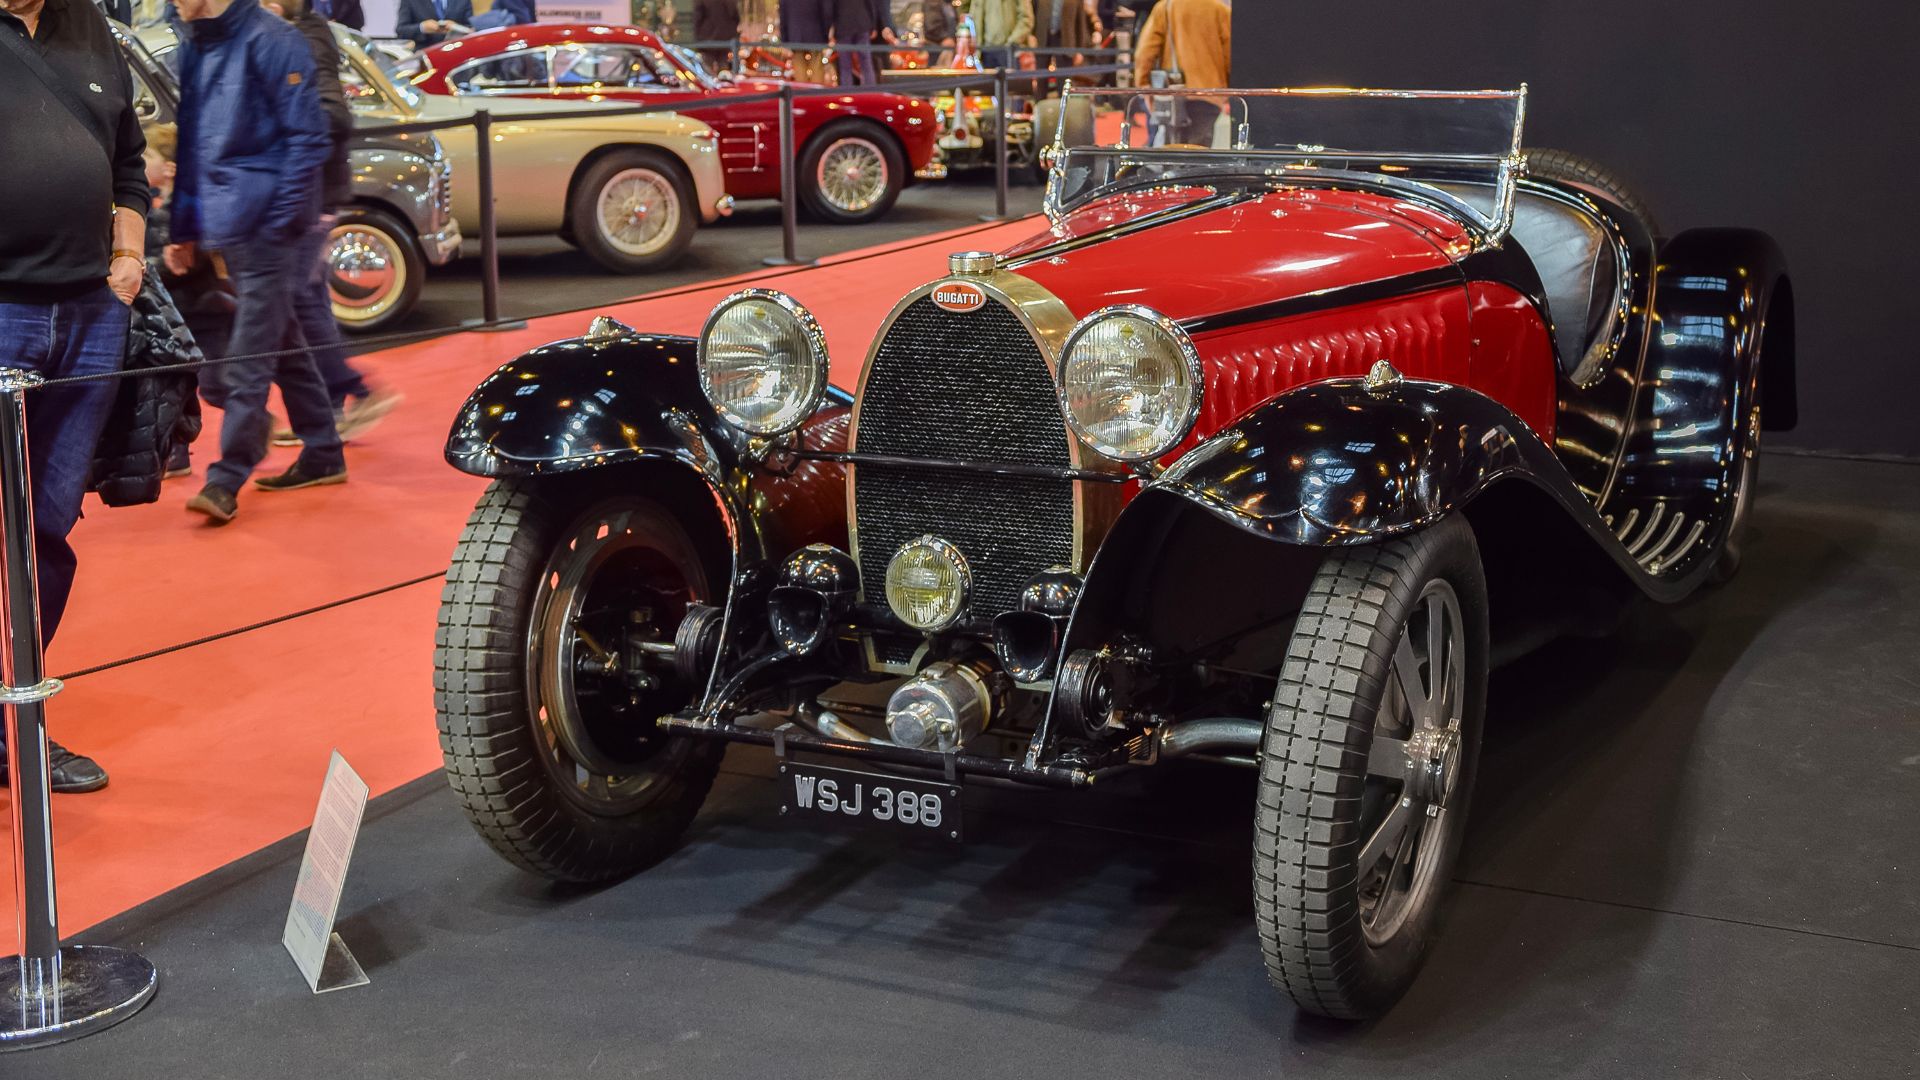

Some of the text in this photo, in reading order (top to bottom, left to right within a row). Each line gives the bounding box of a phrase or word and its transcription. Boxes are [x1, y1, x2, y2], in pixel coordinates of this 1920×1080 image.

[937, 291, 979, 305] BUGATTI
[795, 774, 942, 828] WSJ 388
